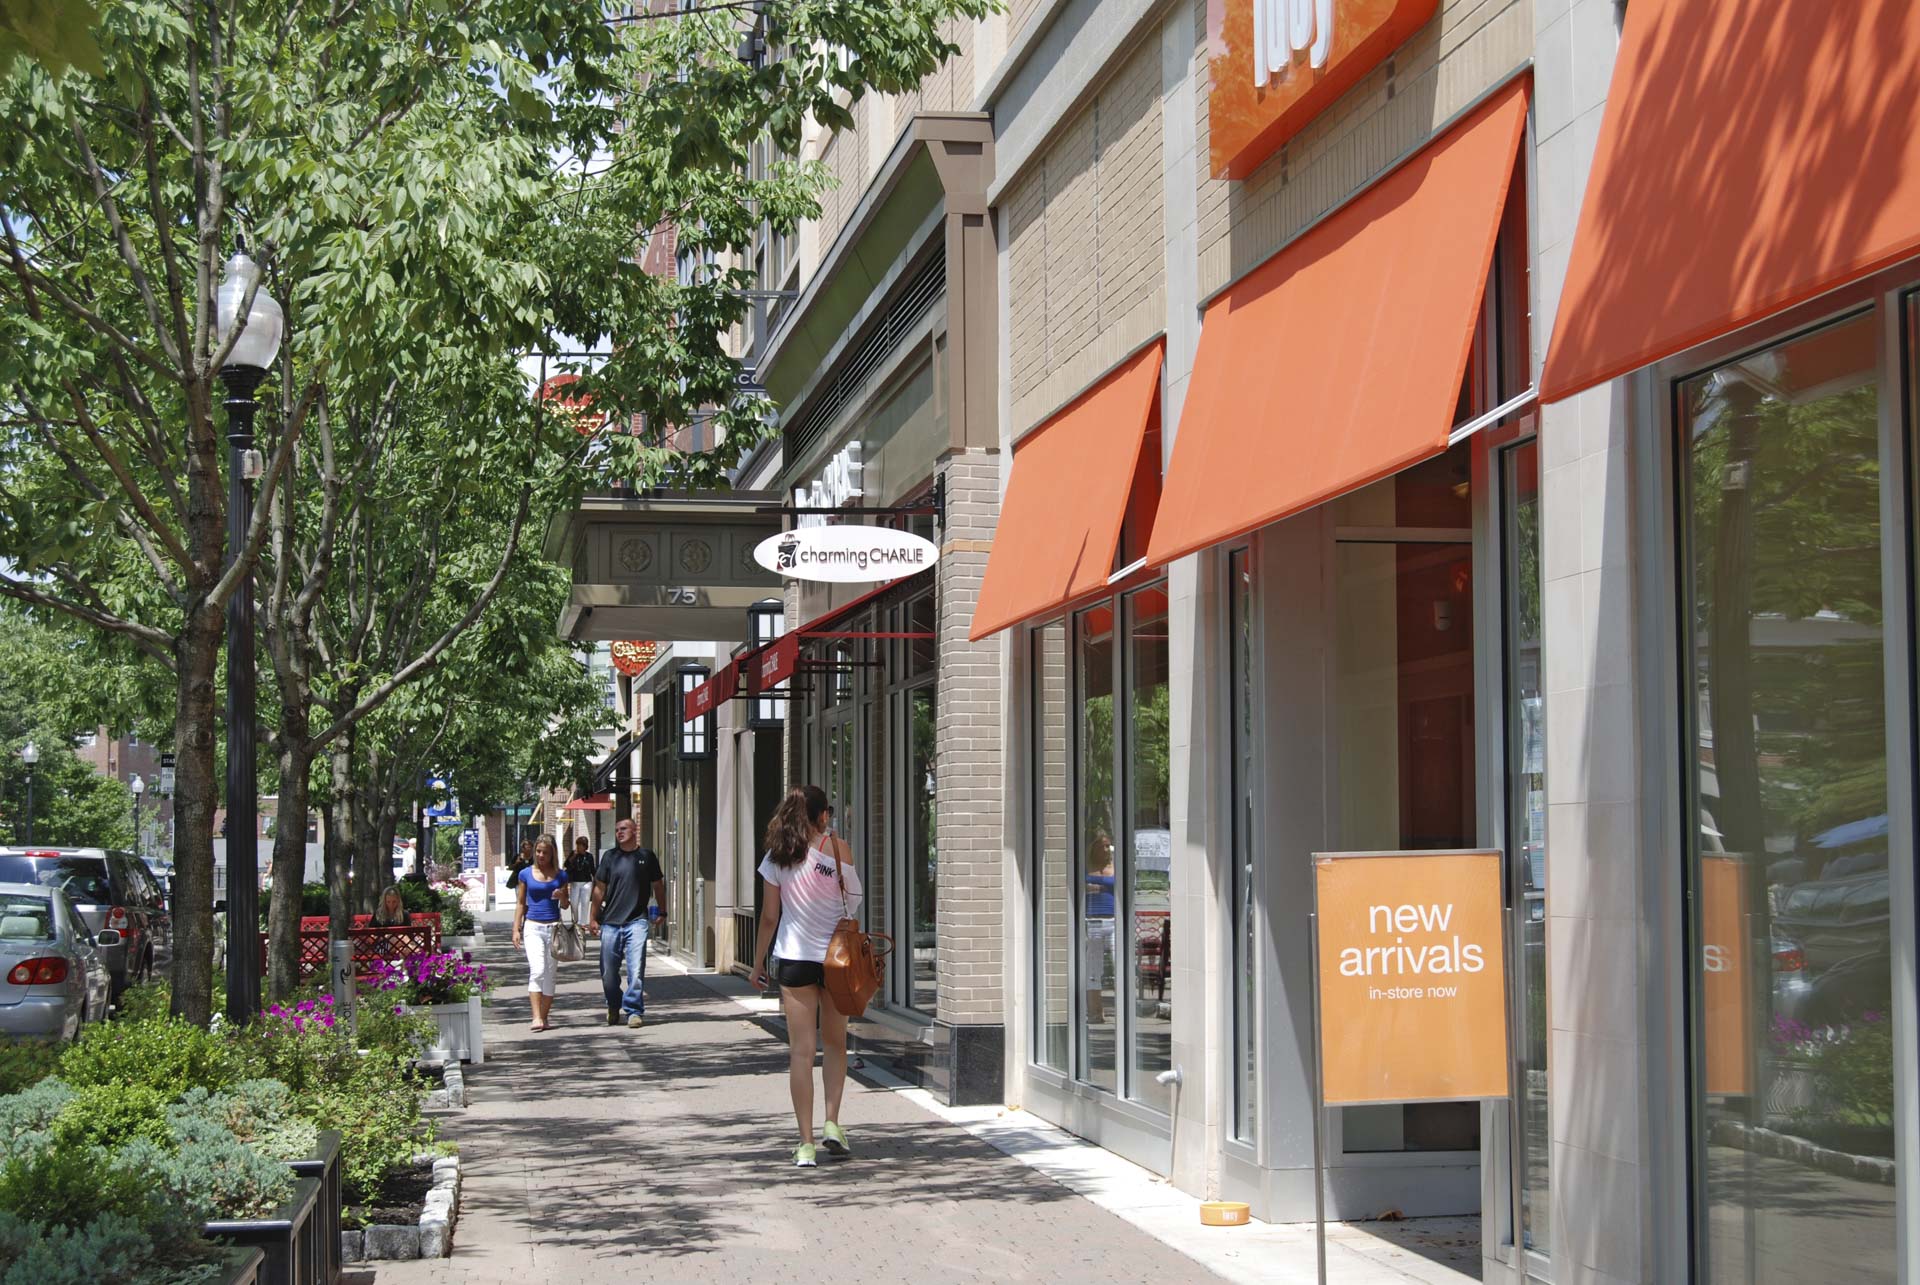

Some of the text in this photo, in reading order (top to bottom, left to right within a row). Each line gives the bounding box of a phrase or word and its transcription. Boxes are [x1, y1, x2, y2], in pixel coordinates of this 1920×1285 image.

[800, 545, 924, 570] charming CHARLIE
[667, 587, 696, 604] 75
[814, 862, 836, 878] PINK
[1369, 903, 1453, 934] new
[1339, 935, 1485, 977] arrivals
[1368, 986, 1457, 1000] in-store now
